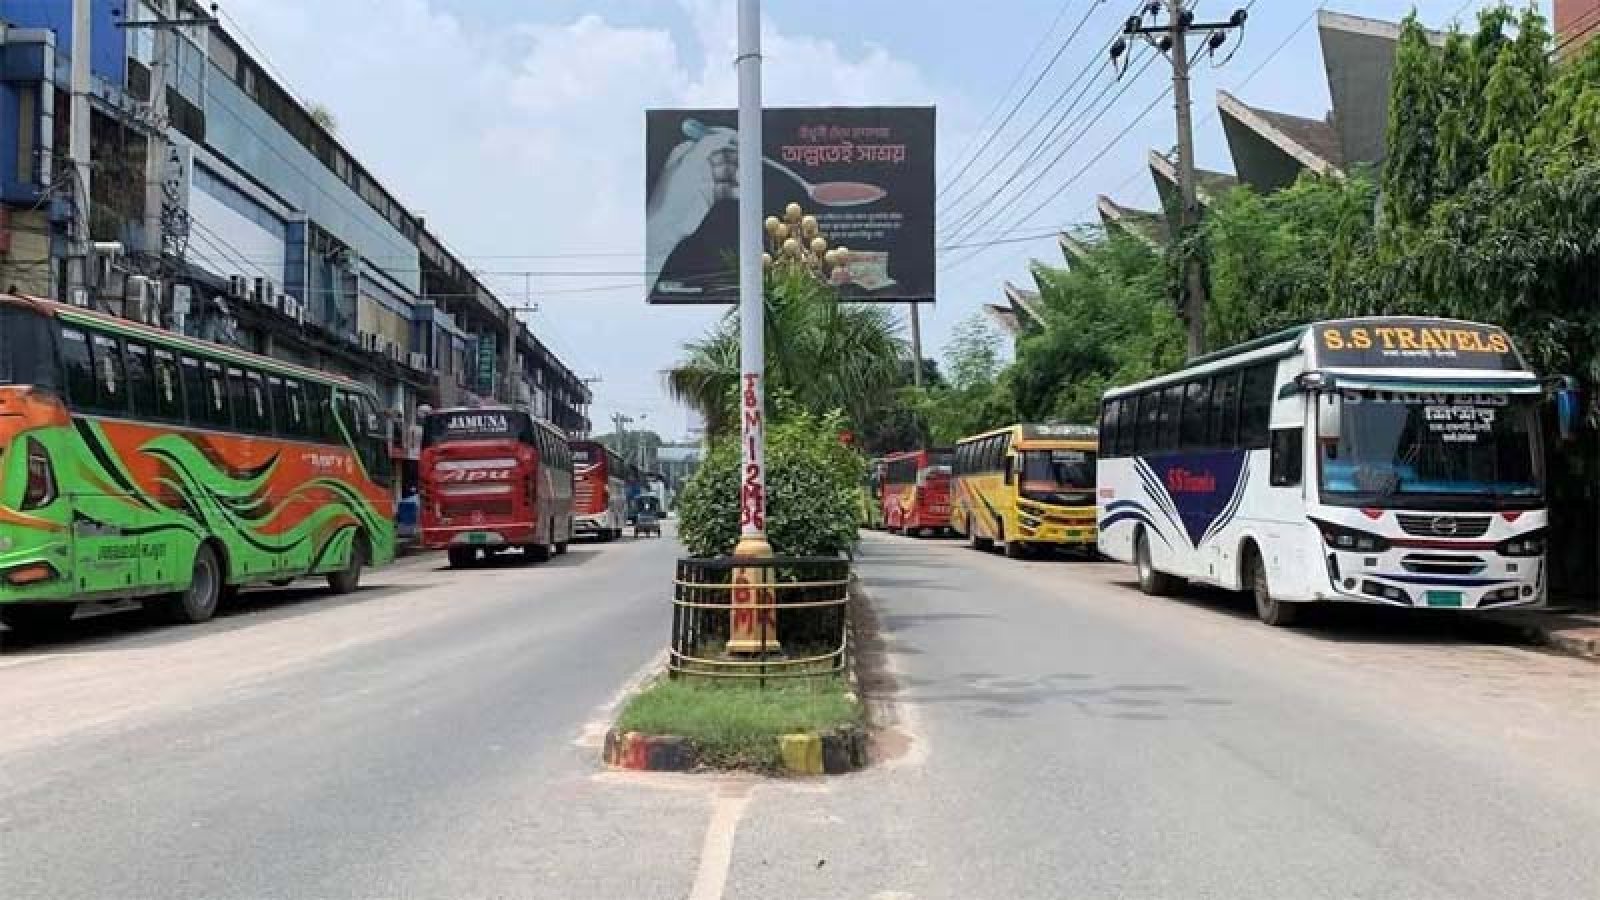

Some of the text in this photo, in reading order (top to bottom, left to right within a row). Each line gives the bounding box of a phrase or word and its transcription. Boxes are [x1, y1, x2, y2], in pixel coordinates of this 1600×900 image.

[1323, 327, 1509, 353] S.S TRAVELS
[447, 415, 508, 432] JAMUNA
